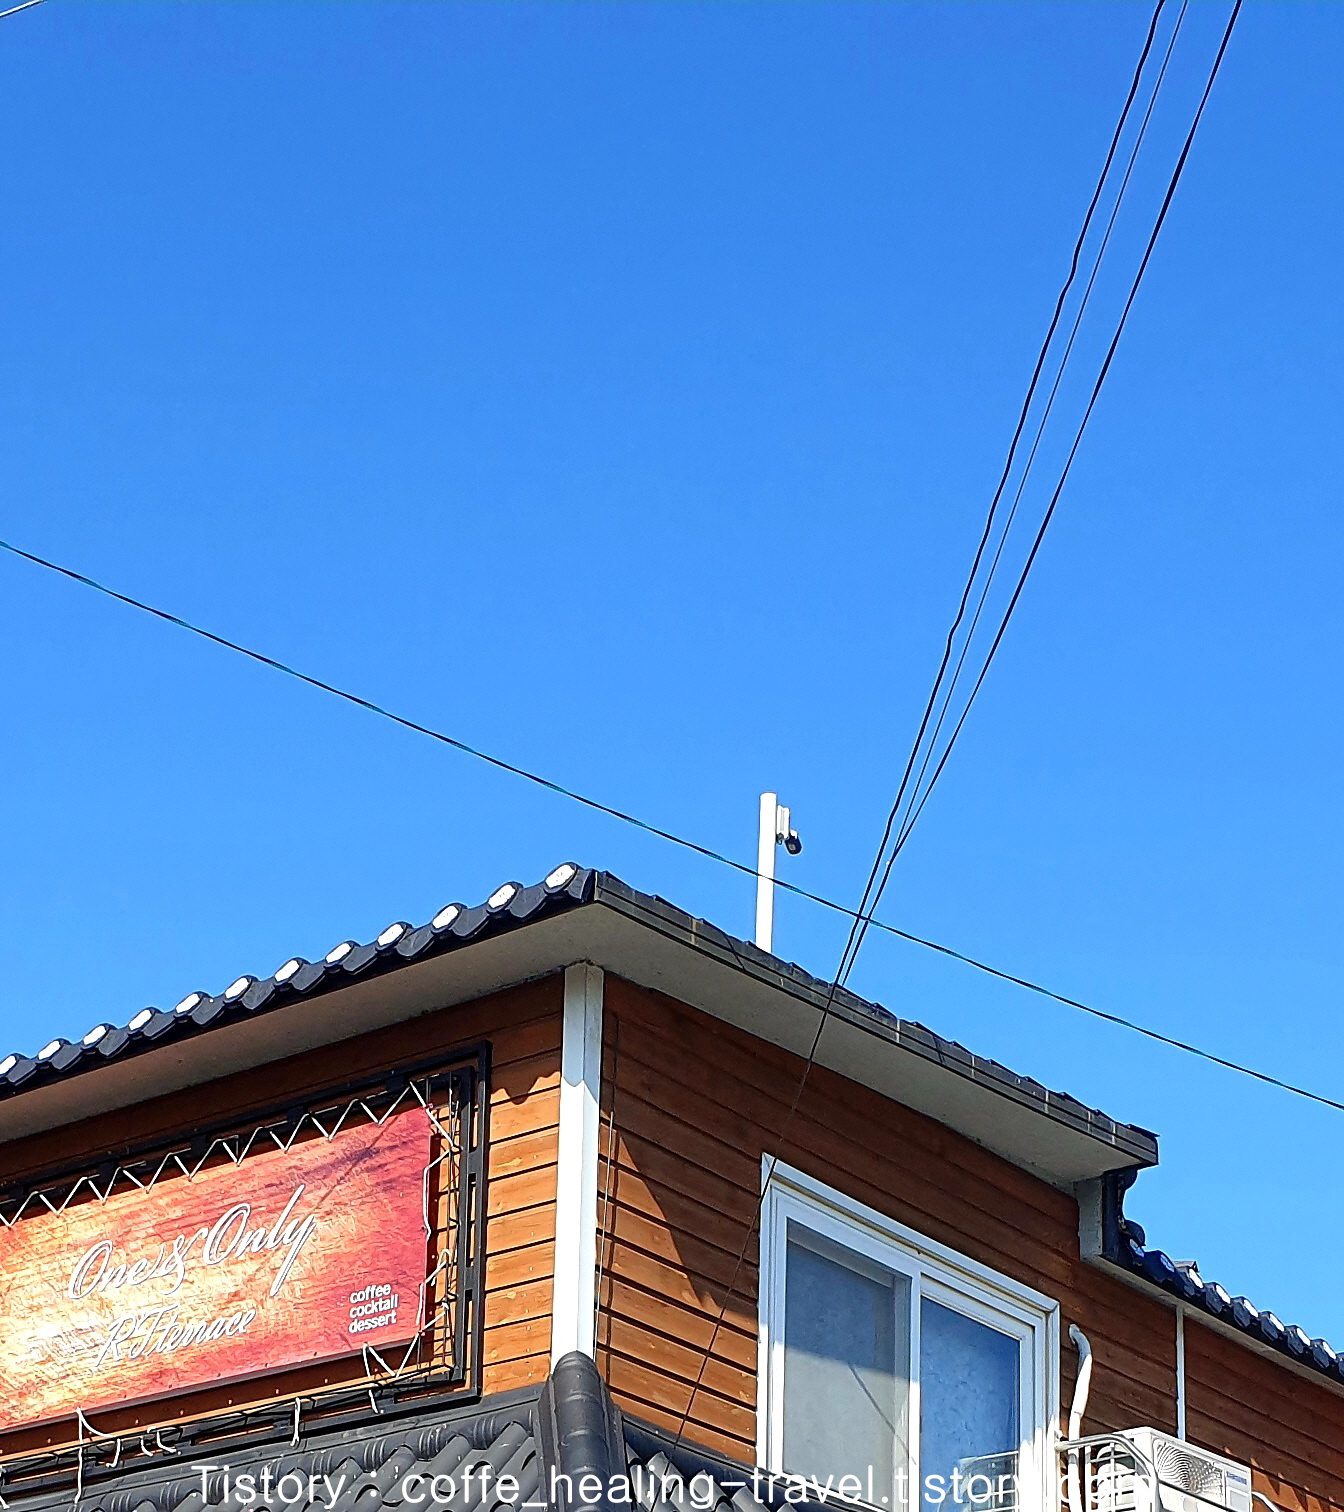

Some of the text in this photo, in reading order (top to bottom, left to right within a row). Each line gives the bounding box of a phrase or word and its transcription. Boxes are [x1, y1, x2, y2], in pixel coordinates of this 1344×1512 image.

[349, 1283, 392, 1304] coffee
[349, 1293, 399, 1319] cocktail
[348, 1310, 397, 1334] dessert
